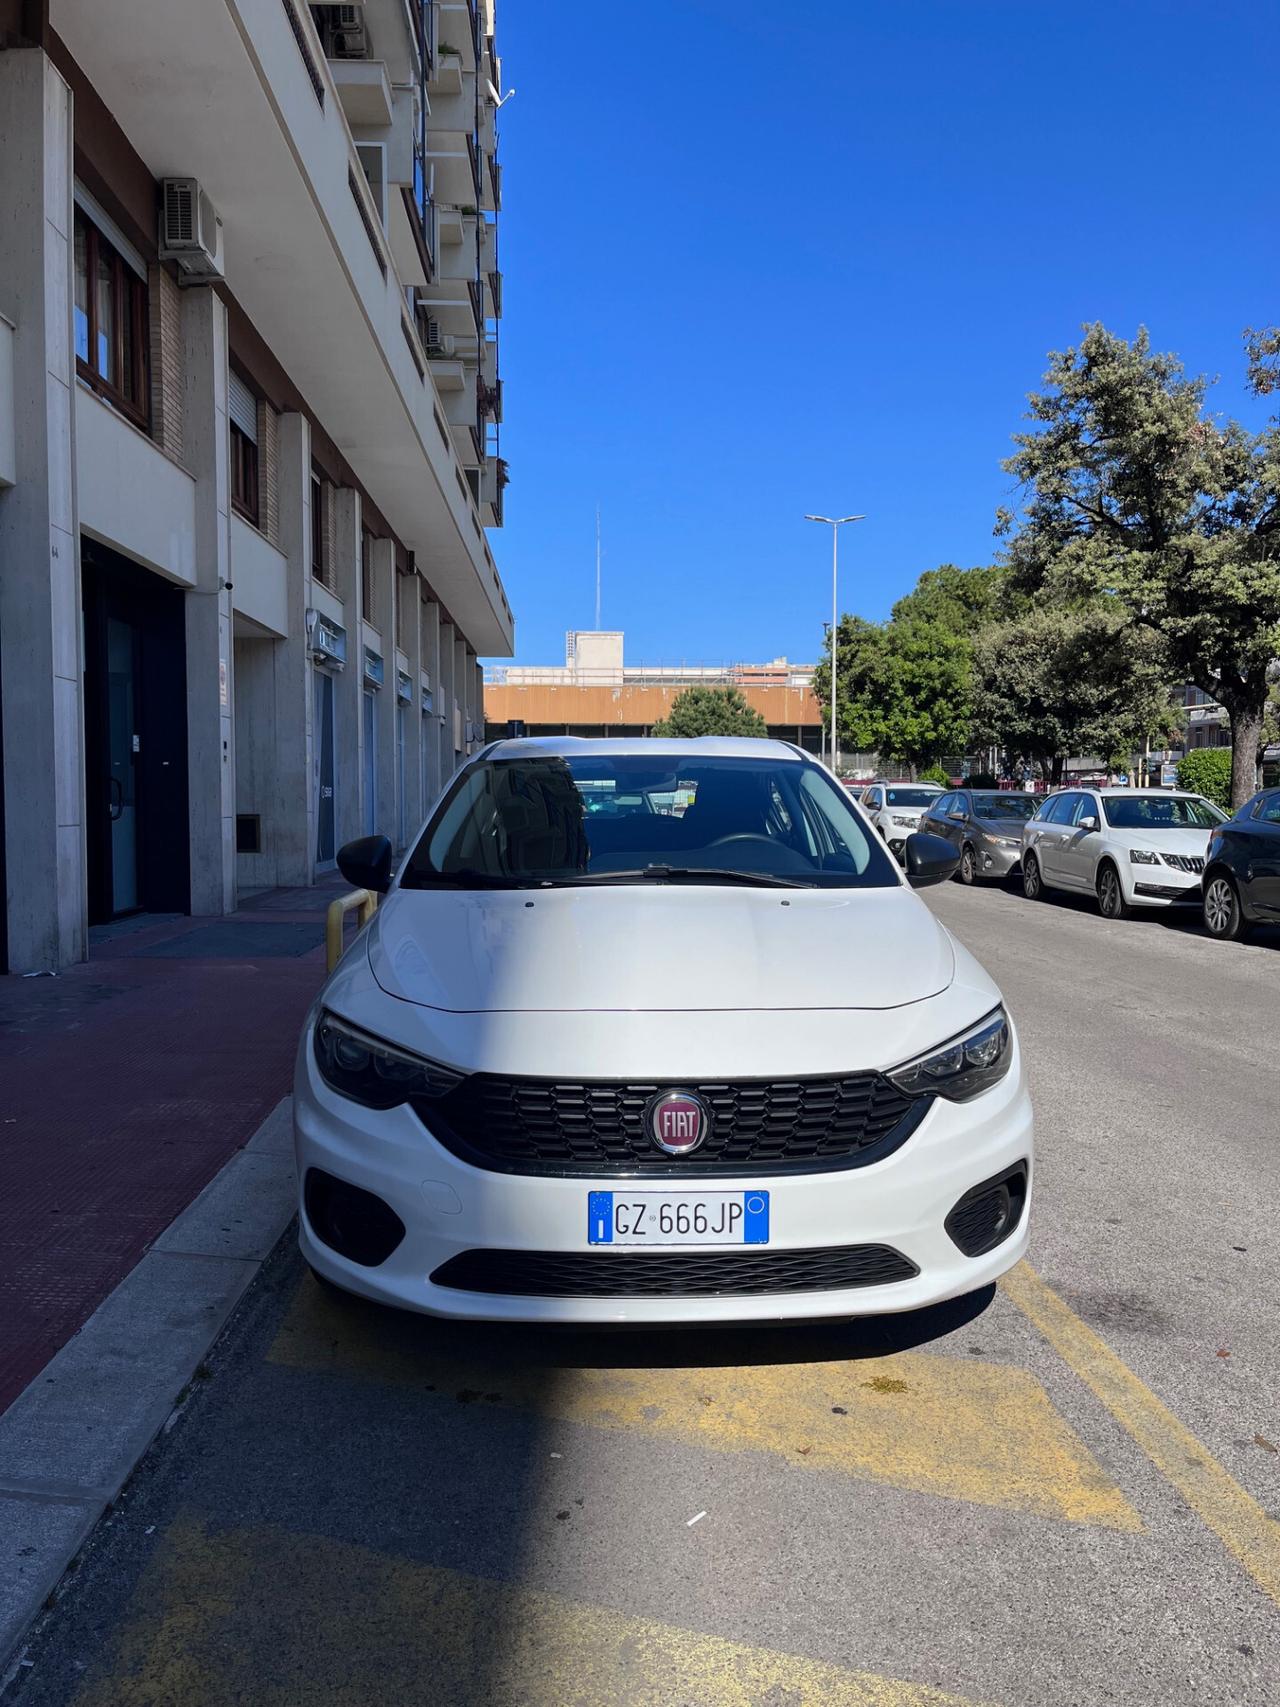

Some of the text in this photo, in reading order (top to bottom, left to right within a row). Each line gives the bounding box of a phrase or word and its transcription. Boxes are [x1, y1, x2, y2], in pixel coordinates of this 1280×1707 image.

[663, 1111, 696, 1138] FIAT
[615, 1202, 743, 1235] GZ 666JP
